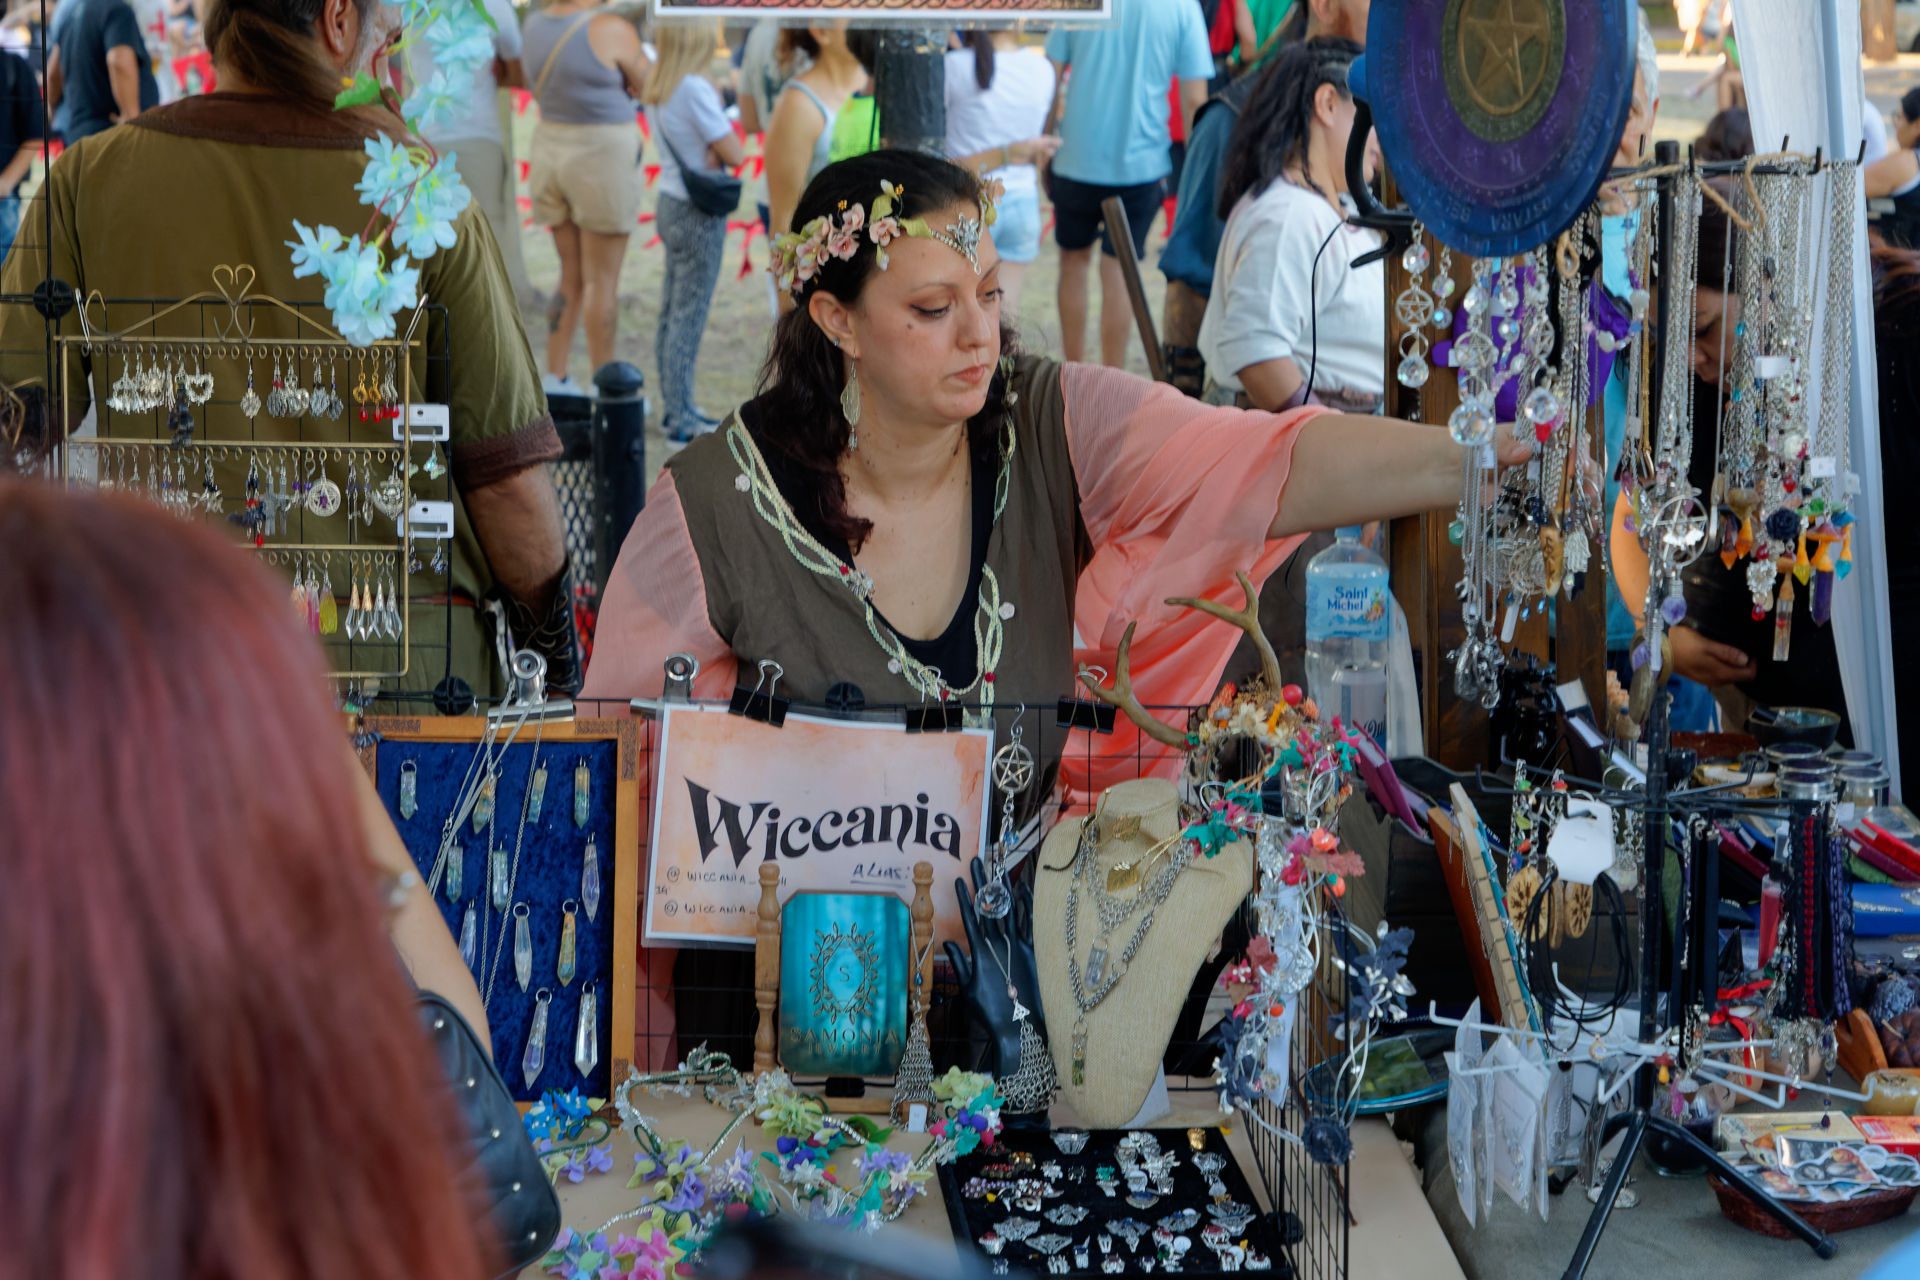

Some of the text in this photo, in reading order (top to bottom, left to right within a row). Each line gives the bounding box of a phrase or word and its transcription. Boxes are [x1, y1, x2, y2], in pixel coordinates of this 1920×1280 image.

[1335, 586, 1368, 600] Saint
[1328, 598, 1364, 611] Michel
[684, 775, 962, 869] Wiccania
